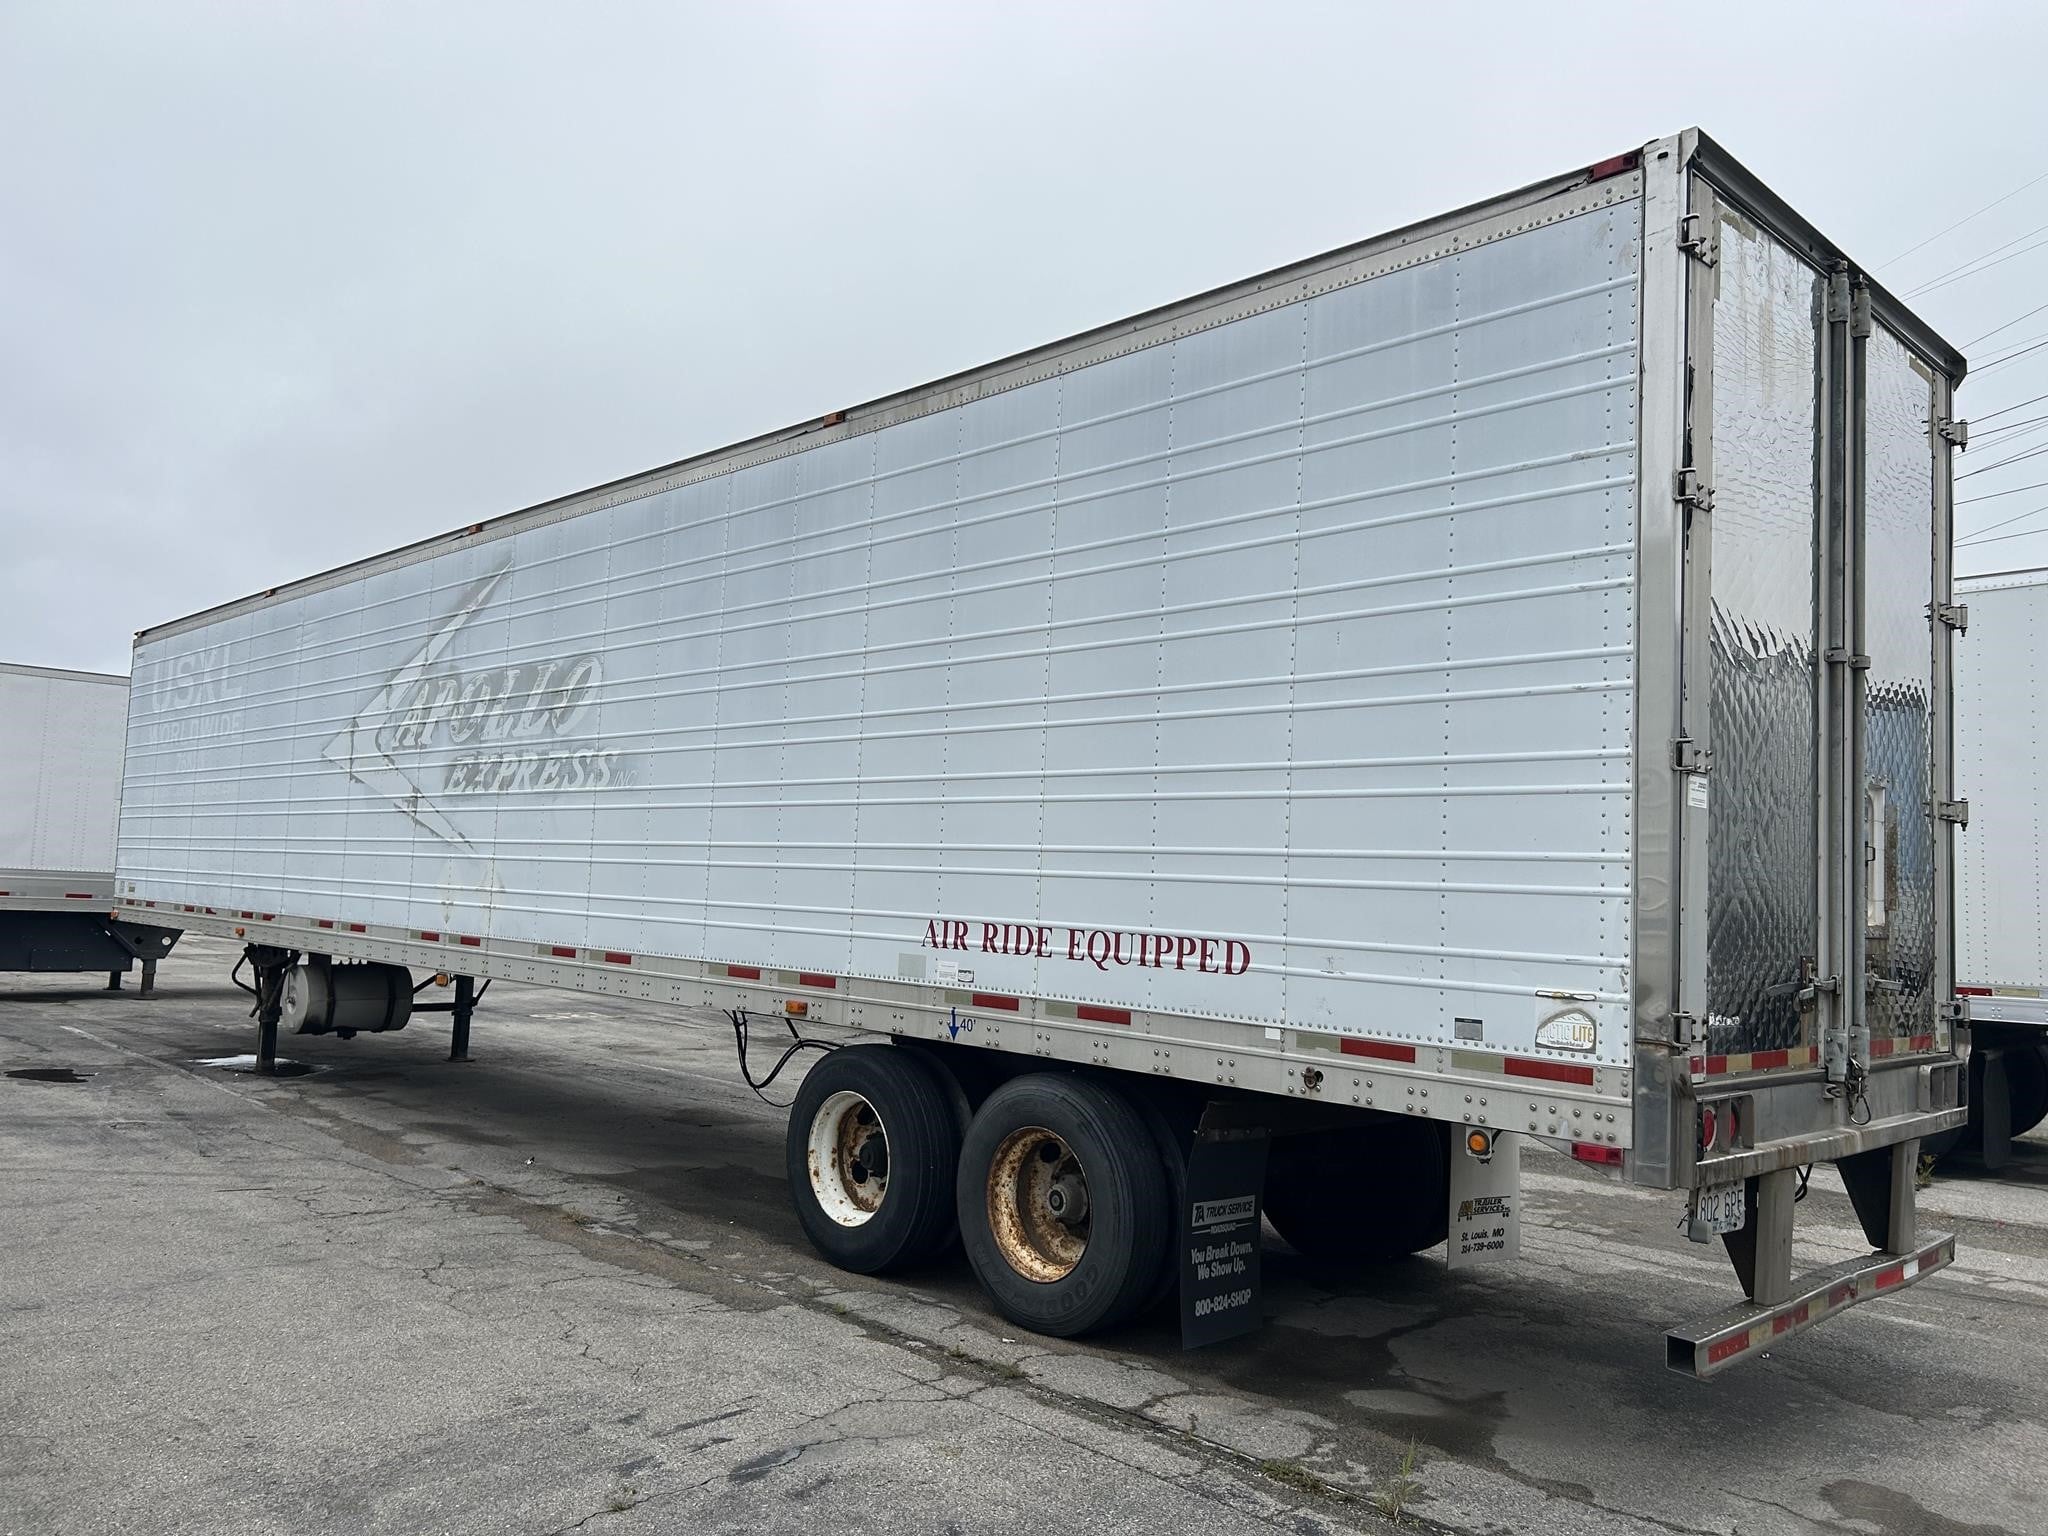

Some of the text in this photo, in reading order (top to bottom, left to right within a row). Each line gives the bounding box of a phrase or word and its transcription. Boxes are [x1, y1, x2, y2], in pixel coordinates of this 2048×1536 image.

[391, 655, 604, 748] APOLLO
[443, 747, 624, 793] EXPRESS
[921, 919, 1251, 976] AIR RIDE EQUIPPED
[1572, 1024, 1593, 1043] LITE
[1194, 1200, 1253, 1224] TA TRUCK SERVICE
[1492, 1228, 1504, 1237] MO
[1191, 1241, 1253, 1265] You Break Down.
[1197, 1257, 1246, 1281] We Show Up.
[1195, 1288, 1251, 1316] 800-824-SHOP
